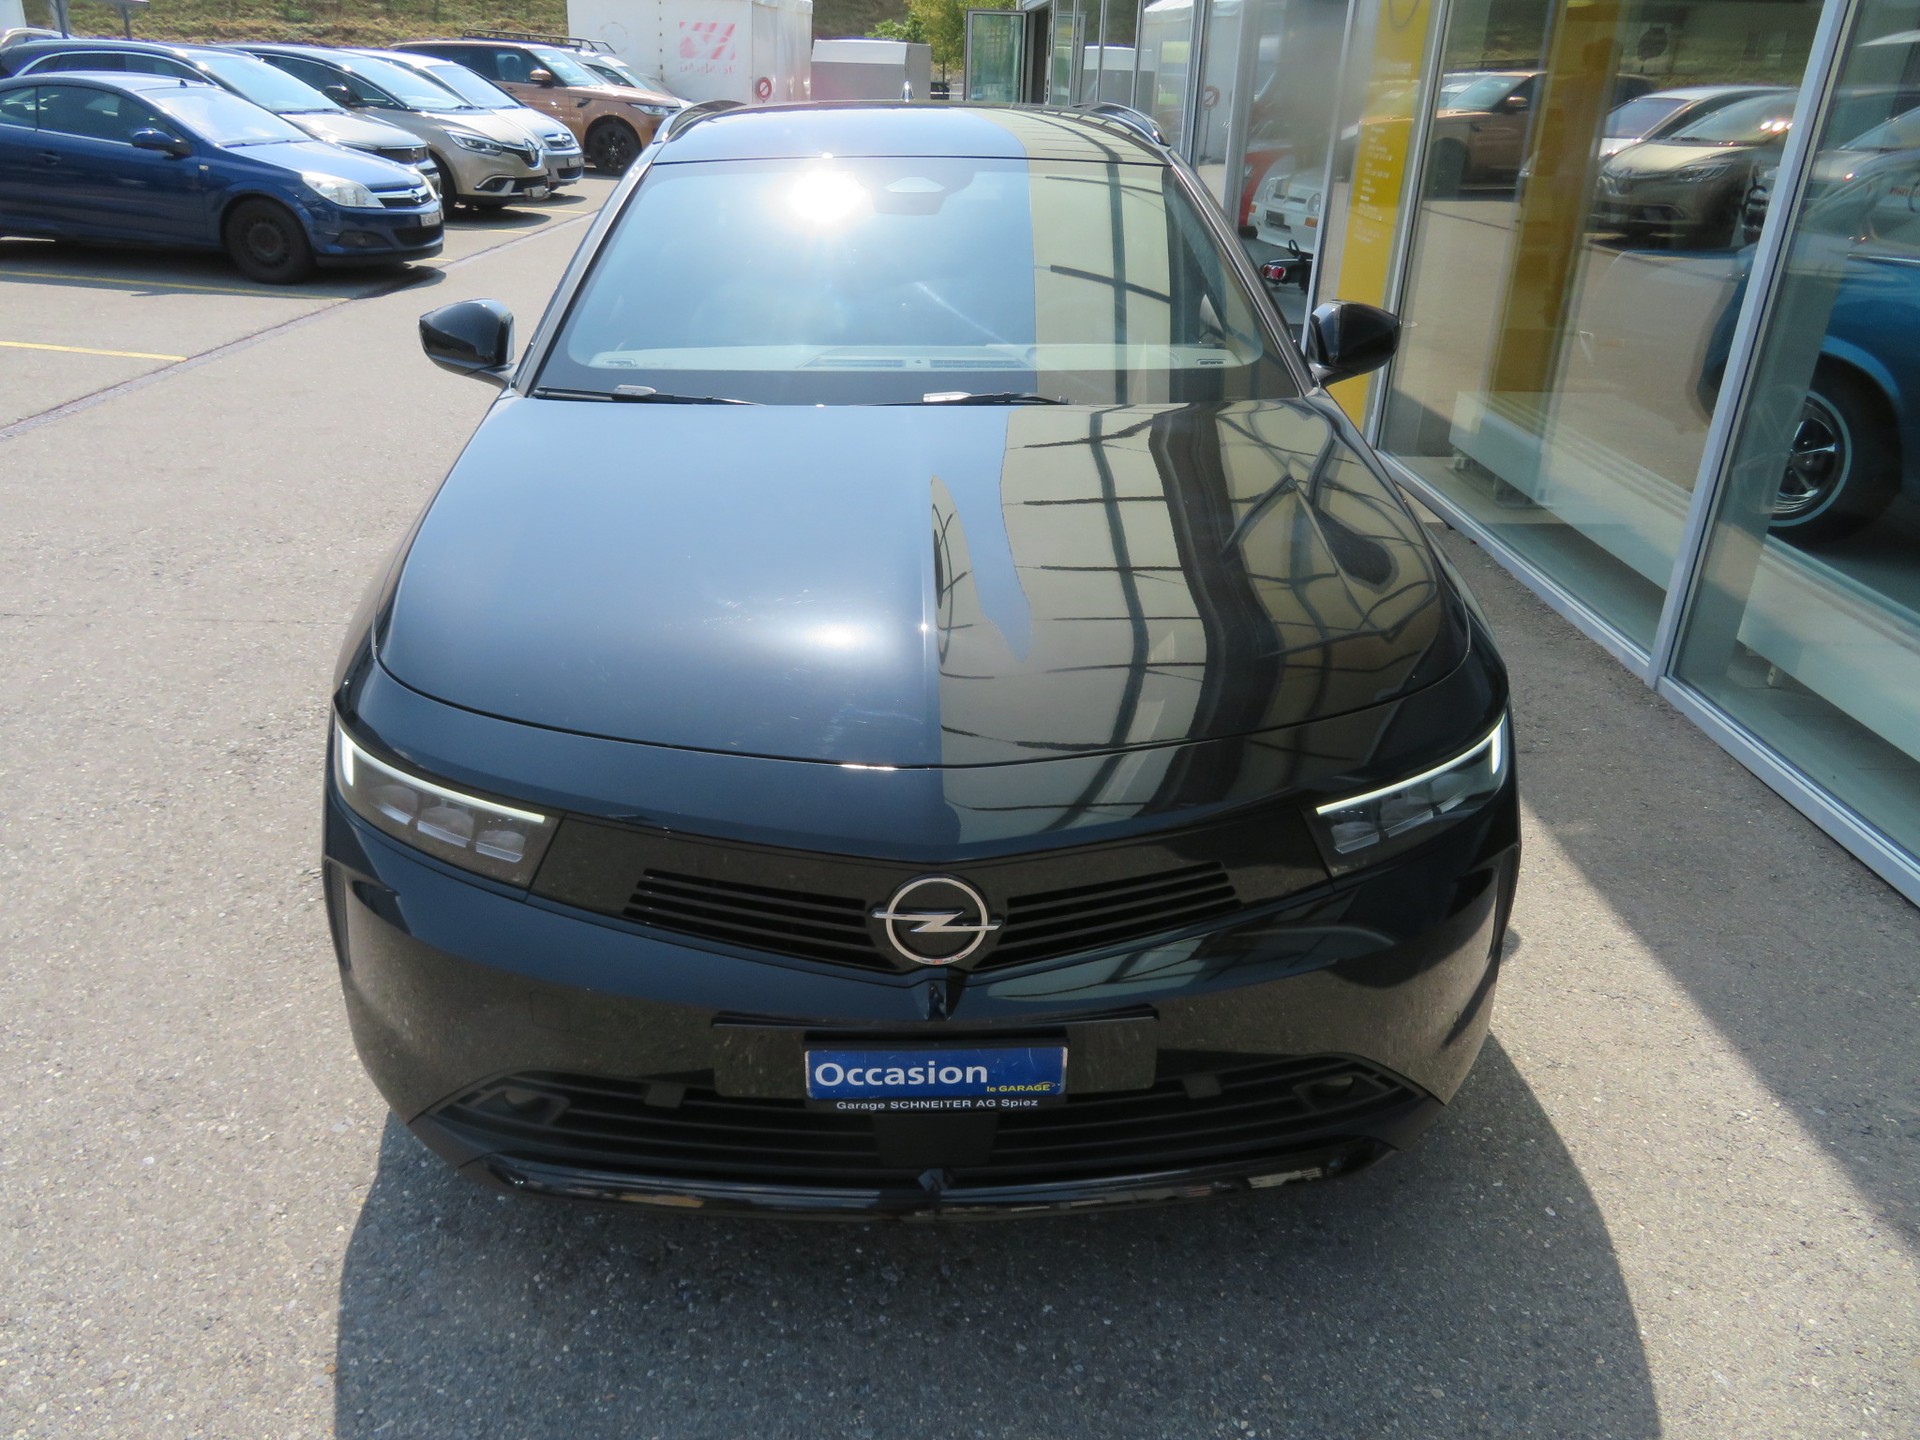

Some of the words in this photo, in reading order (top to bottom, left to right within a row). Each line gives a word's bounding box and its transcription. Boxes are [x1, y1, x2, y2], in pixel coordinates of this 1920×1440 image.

[814, 1060, 988, 1087] Occasion
[998, 1083, 1051, 1092] GARAGE
[836, 1101, 886, 1111] Garage
[890, 1099, 972, 1109] SCHNEITER
[976, 1099, 997, 1108] AG
[1001, 1098, 1039, 1108] Spiez
